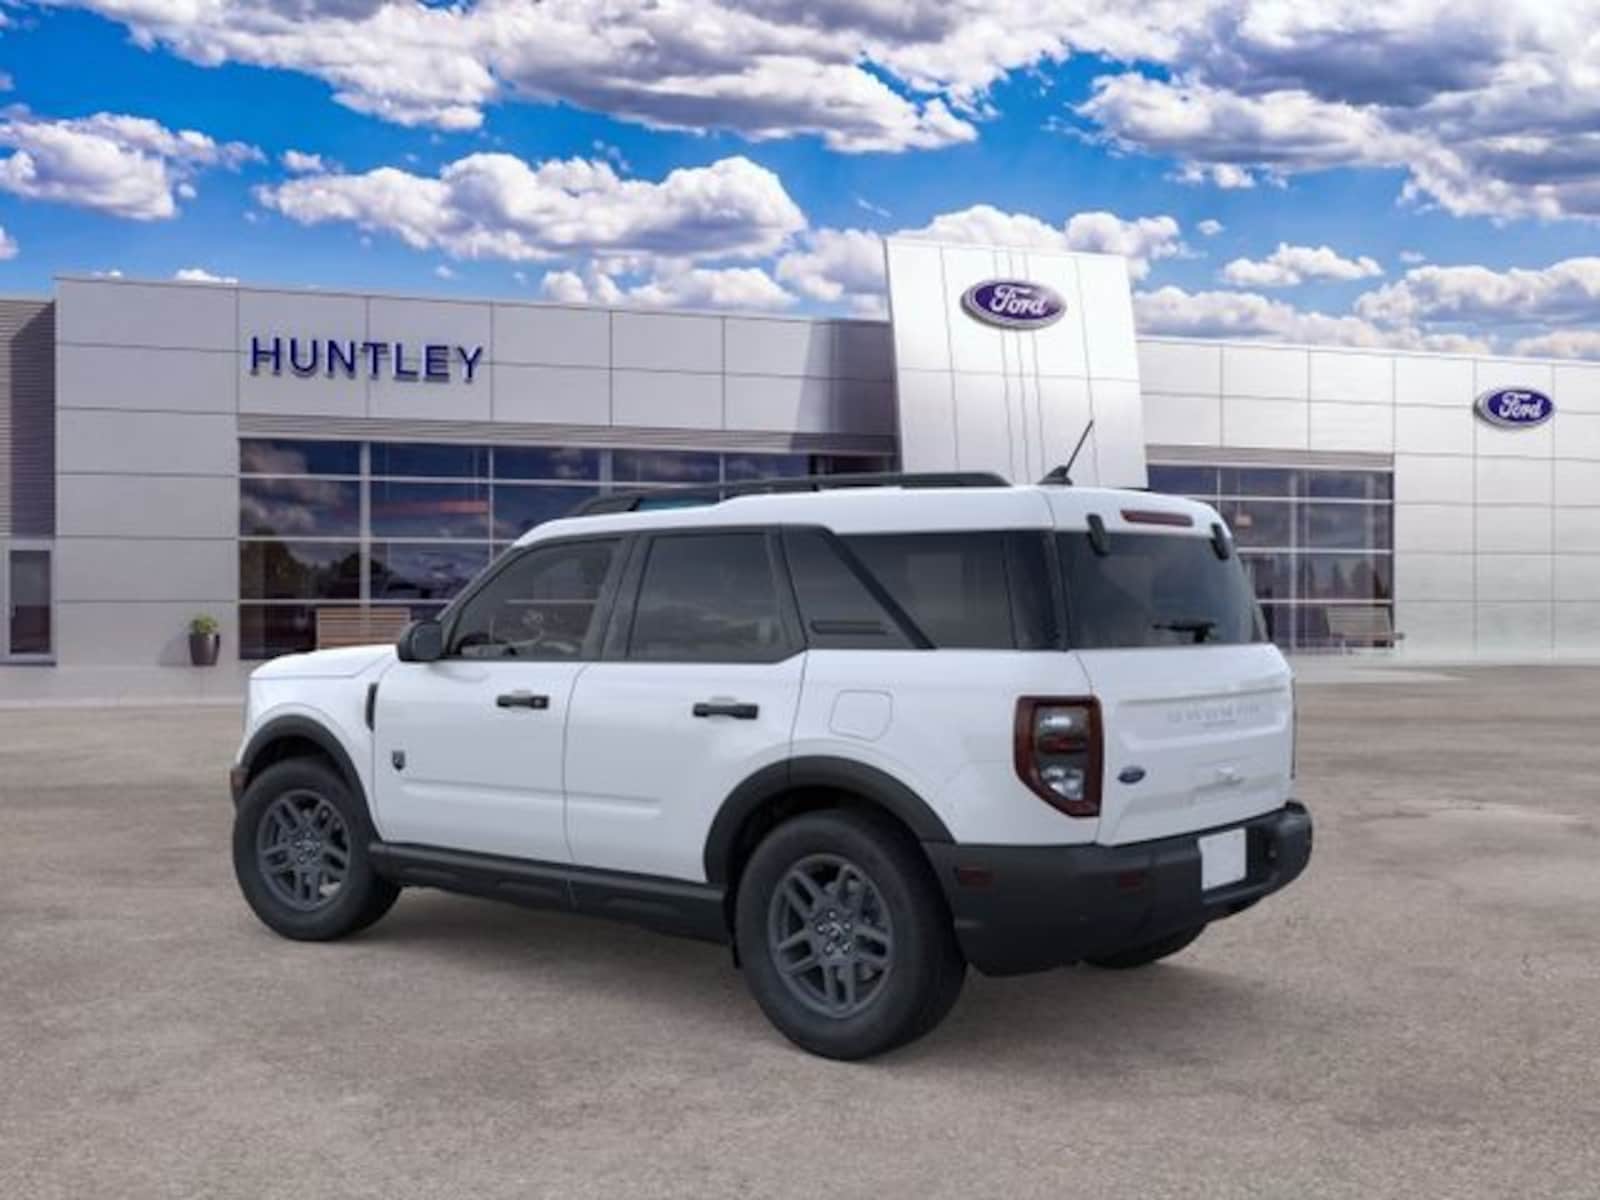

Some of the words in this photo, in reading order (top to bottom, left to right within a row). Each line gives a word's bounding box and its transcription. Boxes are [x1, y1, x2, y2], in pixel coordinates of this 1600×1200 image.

[989, 284, 1048, 315] Ford
[251, 336, 484, 381] HUNTLEY
[1499, 391, 1544, 419] Ford
